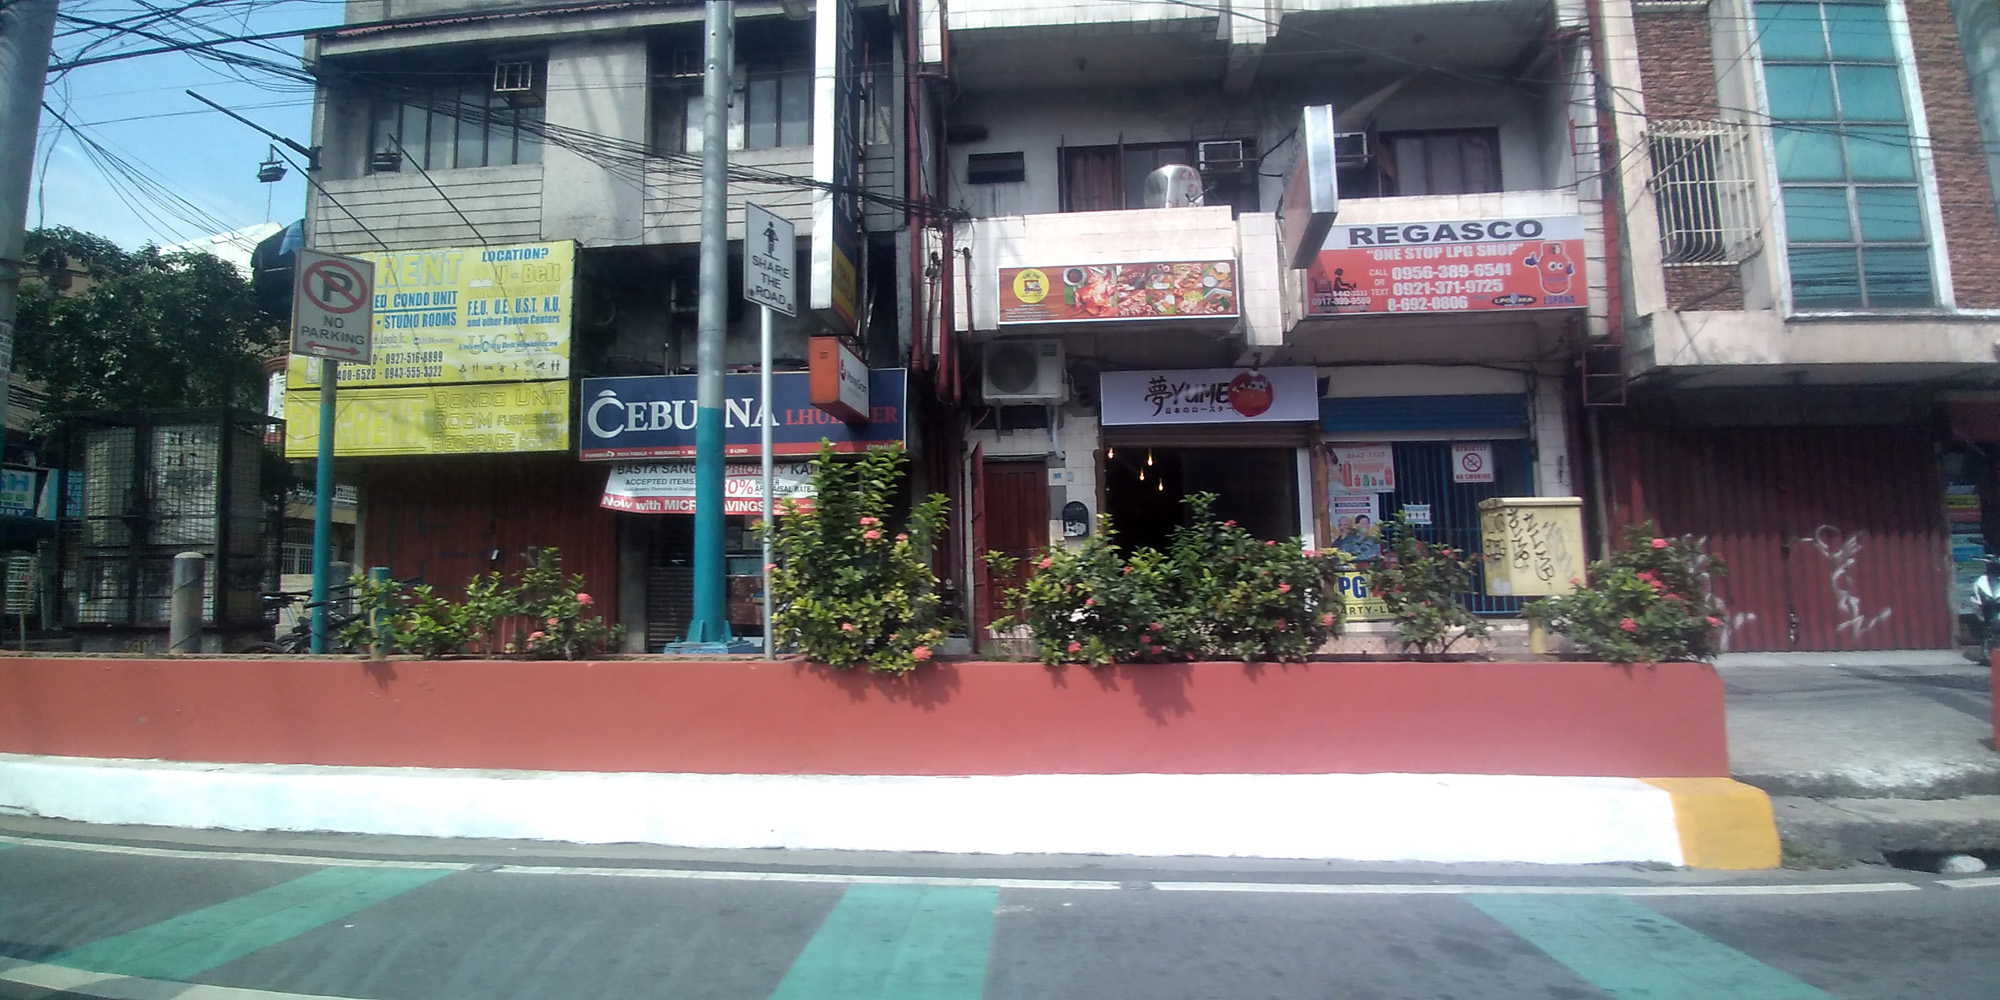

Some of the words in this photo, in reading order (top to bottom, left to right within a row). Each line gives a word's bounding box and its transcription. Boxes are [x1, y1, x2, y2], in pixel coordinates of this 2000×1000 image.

[1348, 219, 1544, 246] REGASCO
[482, 247, 549, 263] LOCATION?
[1404, 246, 1444, 260] STOP
[1445, 244, 1474, 258] LPG
[376, 251, 463, 289] RENT
[522, 263, 561, 283] Belt
[752, 254, 790, 280] SHARE
[1369, 269, 1389, 277] CALL
[1392, 263, 1512, 280] 0956-389-6541
[761, 271, 782, 290] THE
[1393, 279, 1504, 296] 0921-371-9725
[393, 293, 432, 308] CONDO
[433, 290, 459, 306] UNIT
[755, 285, 786, 305] ROAD
[1371, 288, 1389, 296] TEXT
[467, 300, 488, 316] F.E.U.
[494, 299, 509, 314] U.E.
[515, 297, 538, 314] U.S.T.
[544, 295, 561, 312] N.U.
[1387, 295, 1468, 312] 8-692-0806
[323, 315, 345, 329] NO
[384, 313, 421, 330] STUDIO
[421, 311, 457, 328] ROOMS
[467, 318, 481, 327] and
[482, 317, 502, 327] other
[503, 315, 530, 325] Review
[530, 314, 560, 325] Centers
[300, 326, 365, 345] PARKING
[385, 350, 444, 365] 0927-516-8899
[384, 365, 442, 380] 0943-555-3322
[1170, 381, 1230, 405] YUME
[351, 398, 426, 446] RENT
[433, 410, 493, 430] ROOM
[587, 389, 781, 438] CEBUNA
[785, 406, 900, 427] LHUER
[432, 432, 516, 453] BEDSPACE
[617, 464, 658, 475] BASTA
[662, 464, 697, 474] SANG
[724, 464, 787, 474] PRIORTY
[626, 478, 667, 486] ACCEPTED
[755, 485, 793, 493] APAISAL
[602, 496, 633, 509] Now
[635, 499, 662, 511] with
[664, 499, 697, 511] MICR
[724, 500, 764, 513] AVINGS
[1338, 575, 1367, 599] PG
